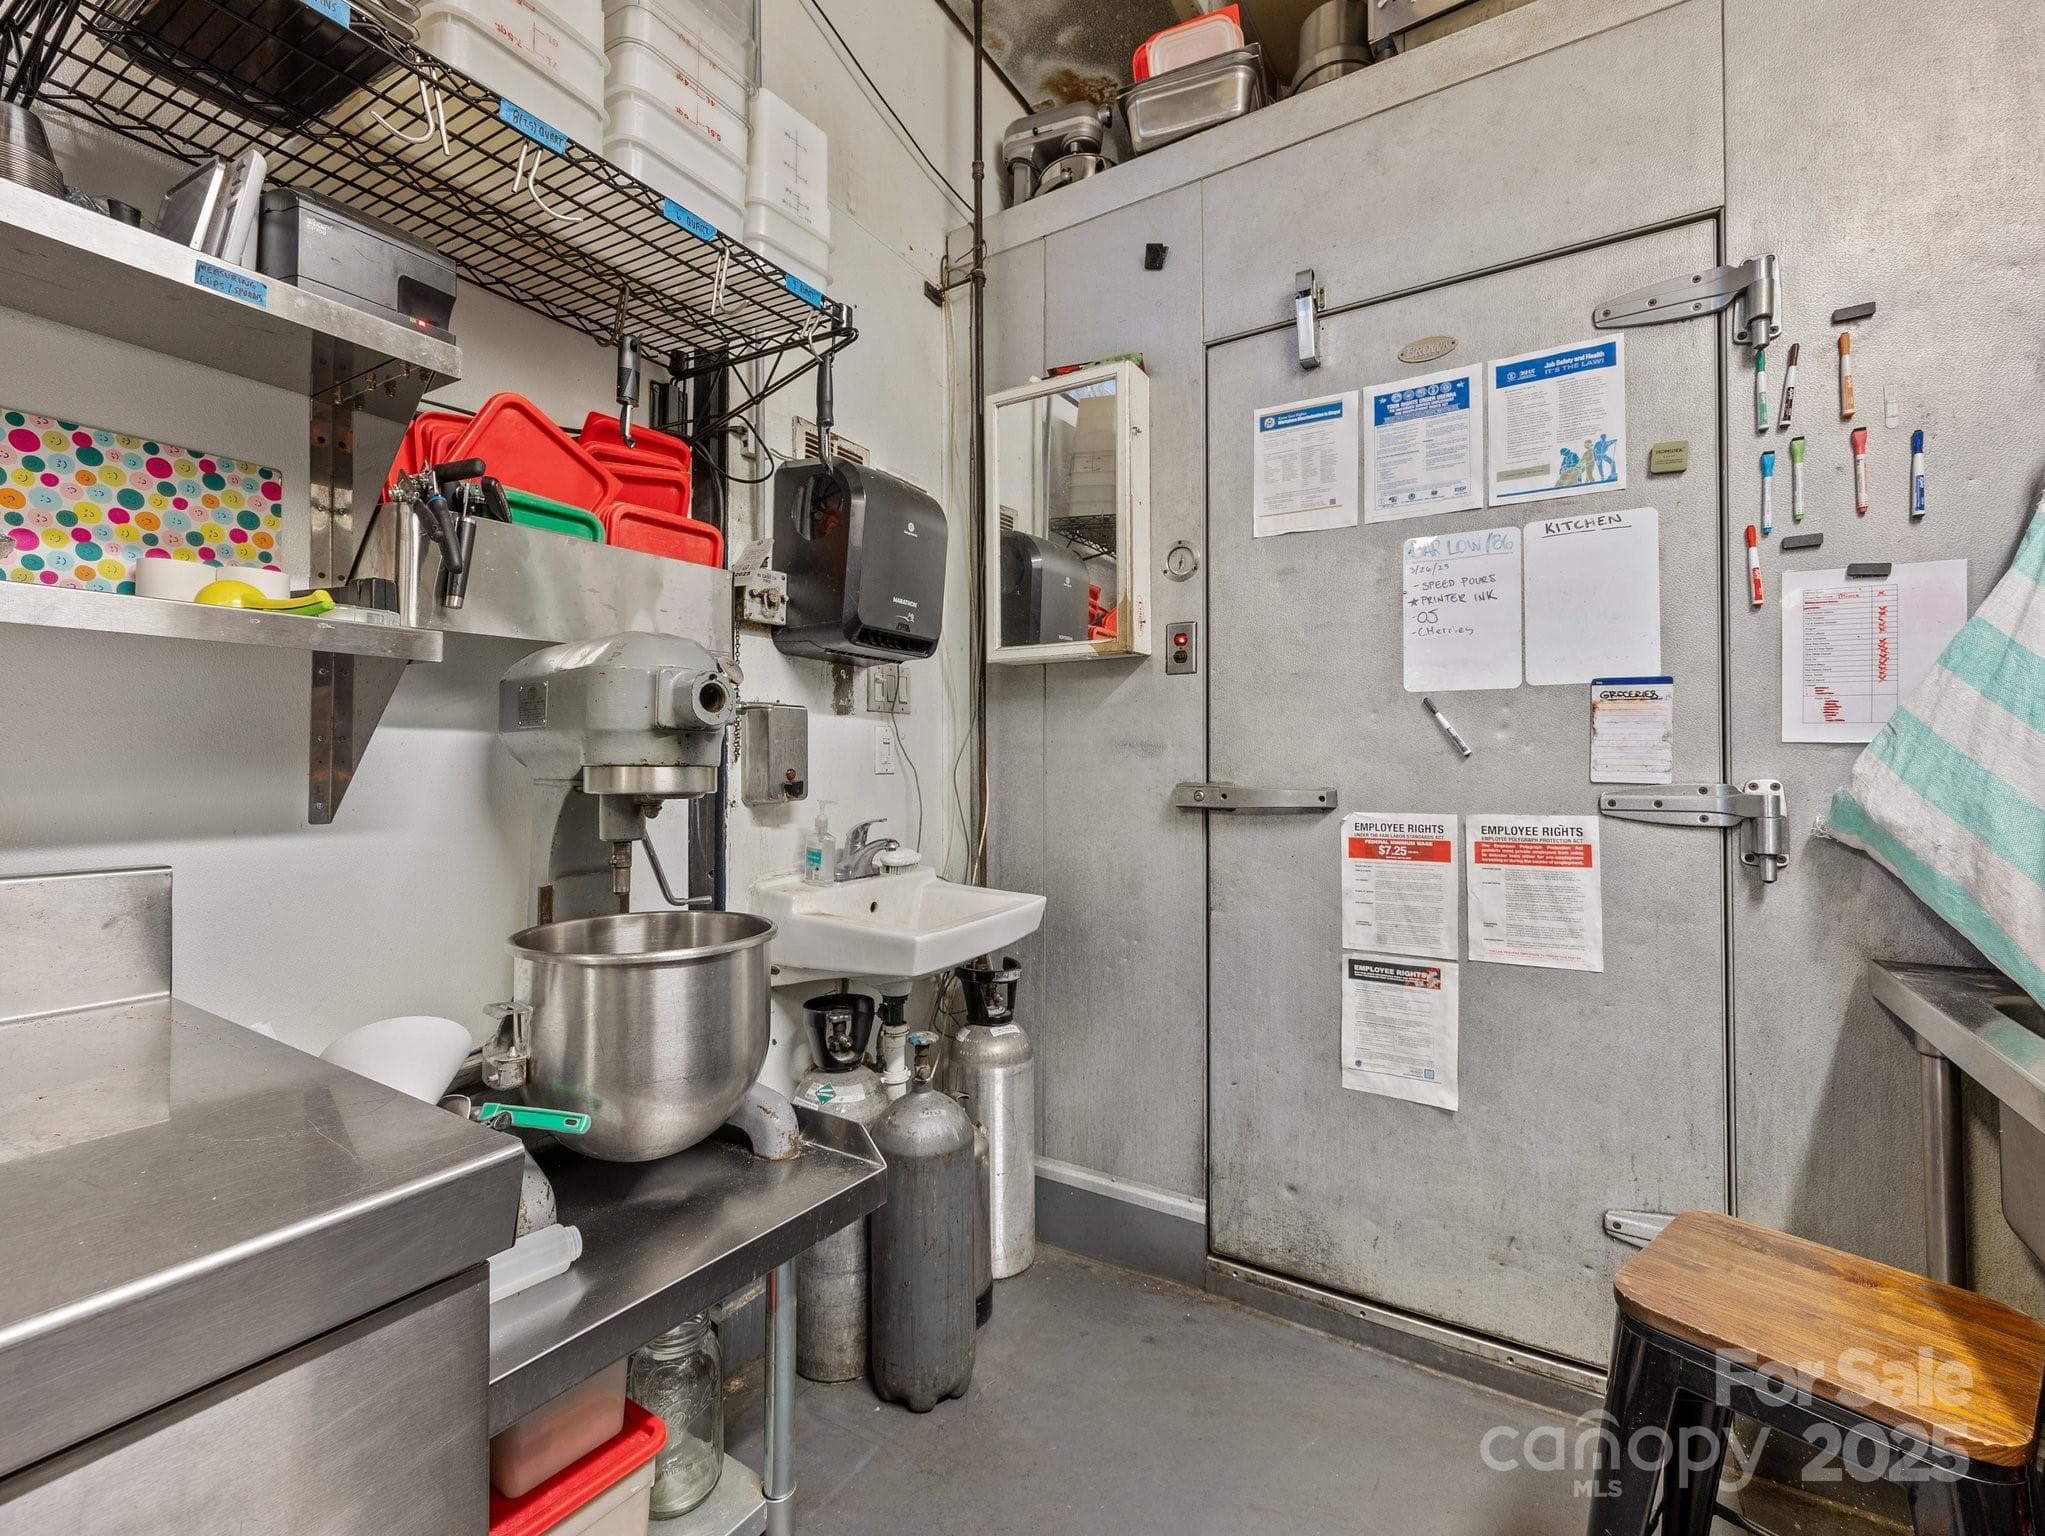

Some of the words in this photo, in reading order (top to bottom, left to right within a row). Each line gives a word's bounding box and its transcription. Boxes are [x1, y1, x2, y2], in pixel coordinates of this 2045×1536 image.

[1556, 357, 1574, 367] Safety
[1574, 353, 1585, 362] and
[1586, 350, 1605, 360] Health
[1562, 362, 1579, 372] THE
[1545, 513, 1622, 534] KITCHEN
[1474, 589, 1498, 602] INK
[1599, 689, 1660, 700] GROCERIES
[1354, 822, 1405, 833] EMPLOYEE
[1407, 824, 1445, 834] RIGHTS
[1481, 825, 1538, 836] EMPLOYEE
[1542, 827, 1584, 838] RIGHTS
[1378, 845, 1407, 857] $7.25
[1353, 964, 1395, 976] EMPLOYEE
[1395, 969, 1428, 979] RIGHTS
